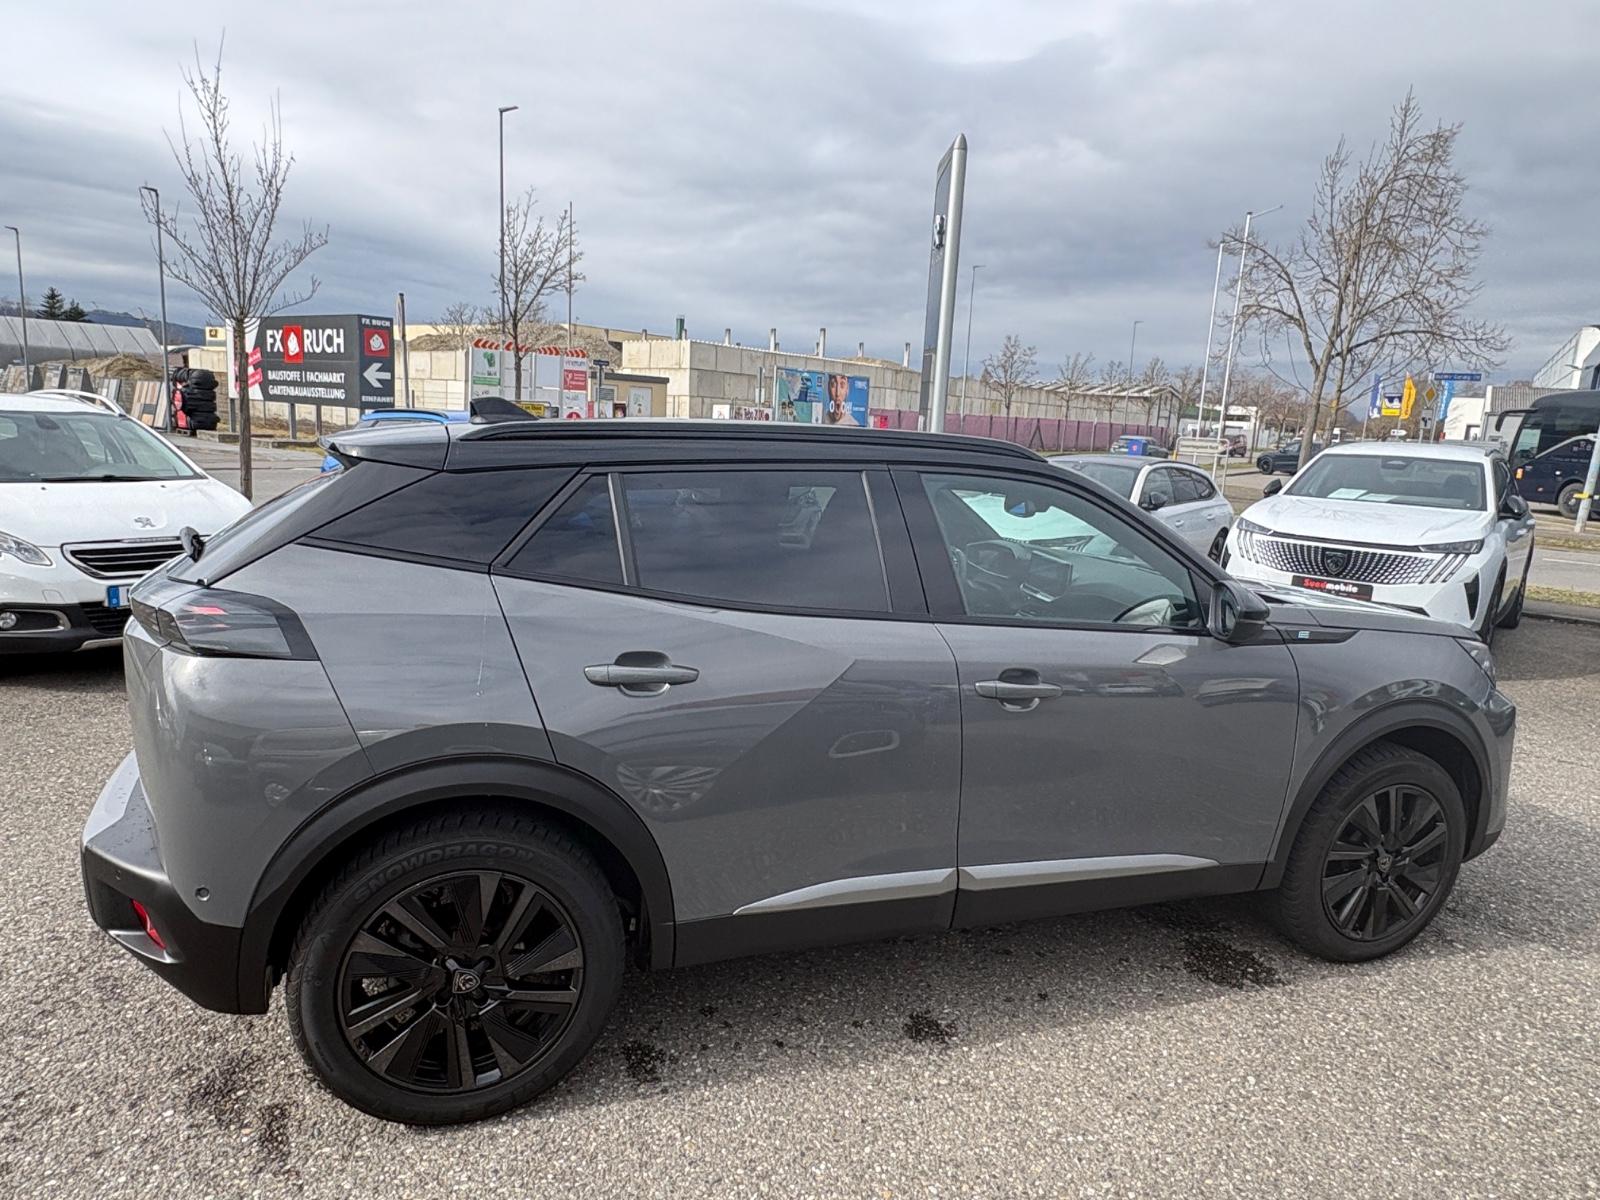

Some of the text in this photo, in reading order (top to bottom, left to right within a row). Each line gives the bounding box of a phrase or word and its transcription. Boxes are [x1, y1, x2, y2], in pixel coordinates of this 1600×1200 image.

[361, 318, 391, 327] FX RUCH
[266, 328, 345, 353] FX RUCH
[267, 370, 301, 382] BAUSTOFFE
[306, 371, 345, 384] FACHMARKT
[268, 385, 346, 400] GARTENBAUAUSSTELLUNG
[361, 395, 394, 403] EINFAHRT
[353, 844, 534, 901] SNOWDRAGON
